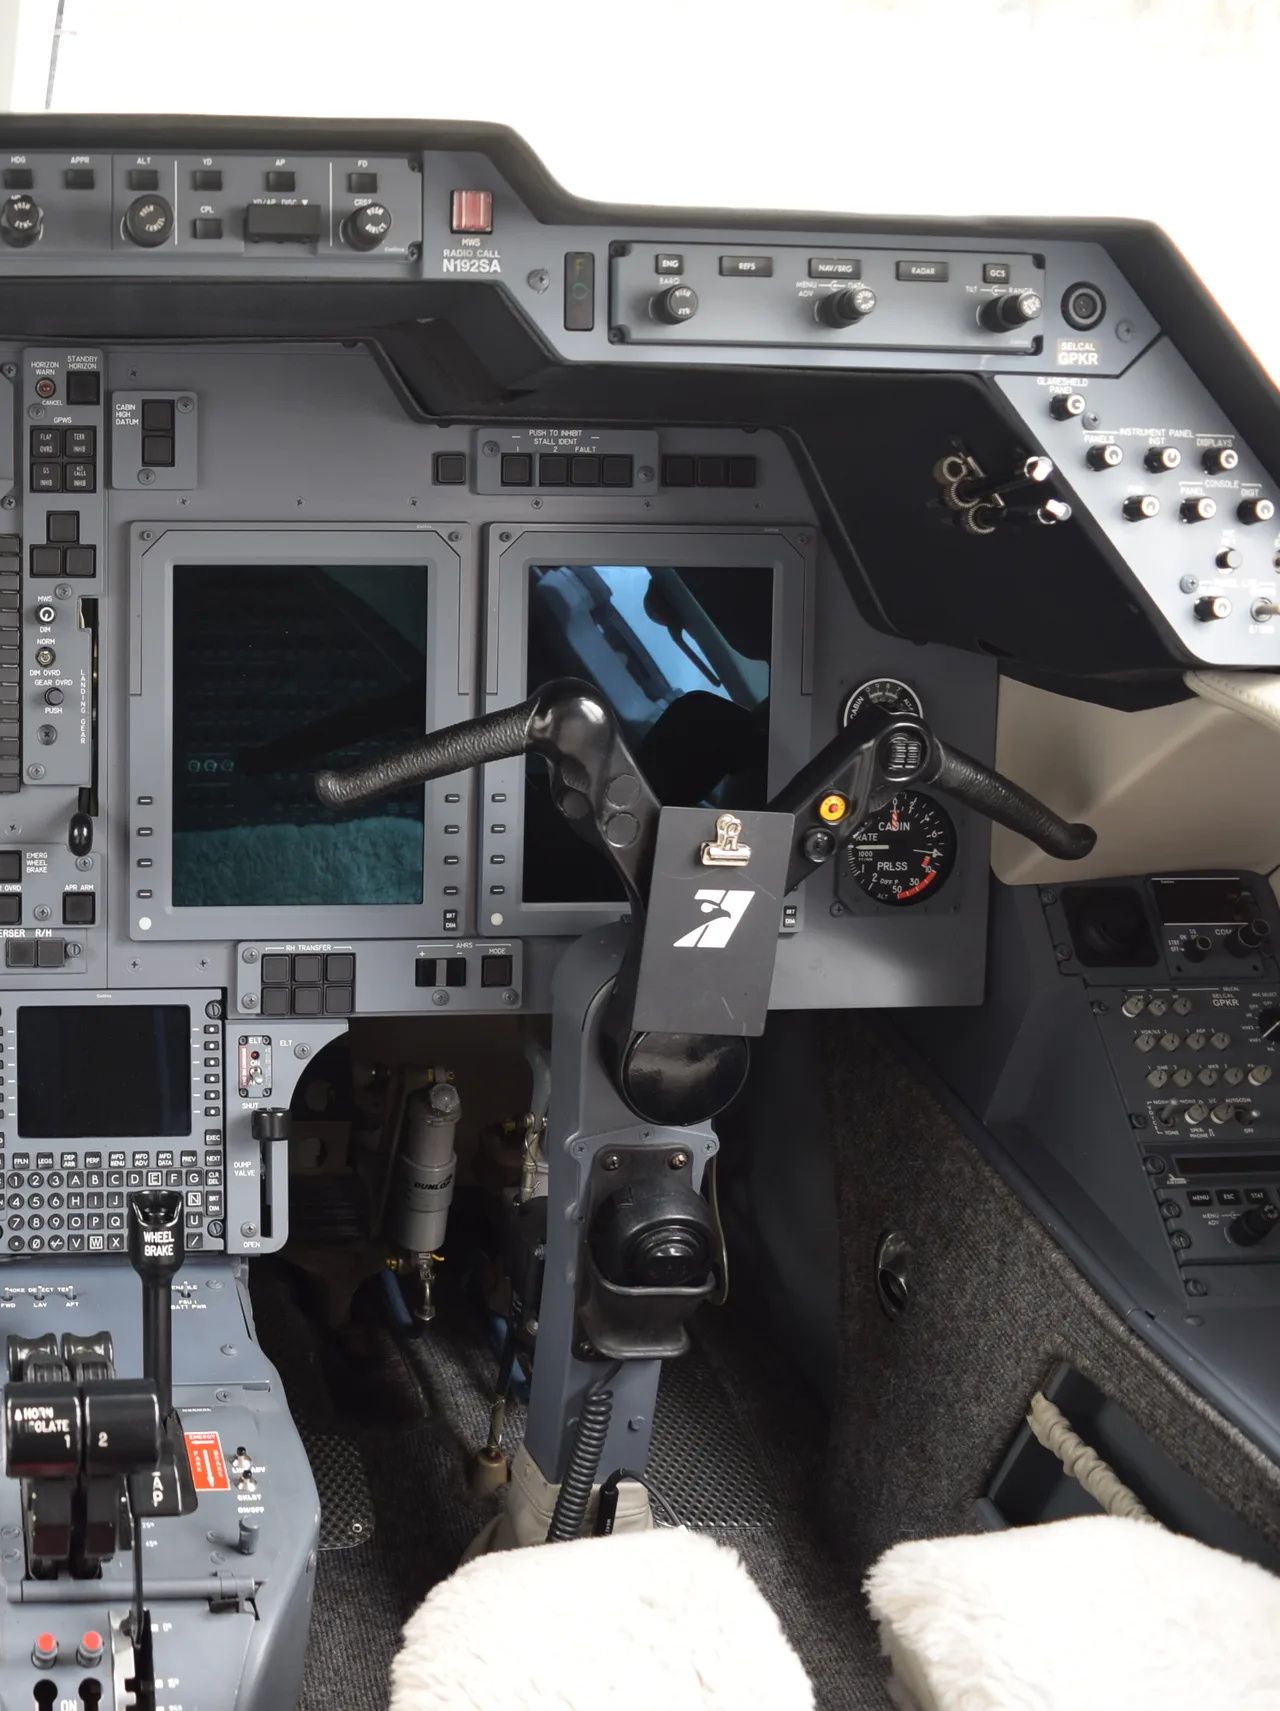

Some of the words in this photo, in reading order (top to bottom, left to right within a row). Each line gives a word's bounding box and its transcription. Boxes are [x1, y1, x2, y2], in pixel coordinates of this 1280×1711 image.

[443, 259, 501, 272] N192SA
[1062, 342, 1095, 350] SELCAL
[1058, 353, 1098, 365] GPKR
[1037, 378, 1088, 387] GLARESHIELD
[1120, 429, 1166, 437] INSTRUMENT
[1085, 435, 1114, 443] PANELS
[1205, 480, 1239, 489] CONSOLE
[1241, 488, 1258, 496] DIGIT
[144, 1231, 174, 1243] WHEEL
[144, 1244, 173, 1256] BRAKE
[99, 1433, 107, 1446] 2
